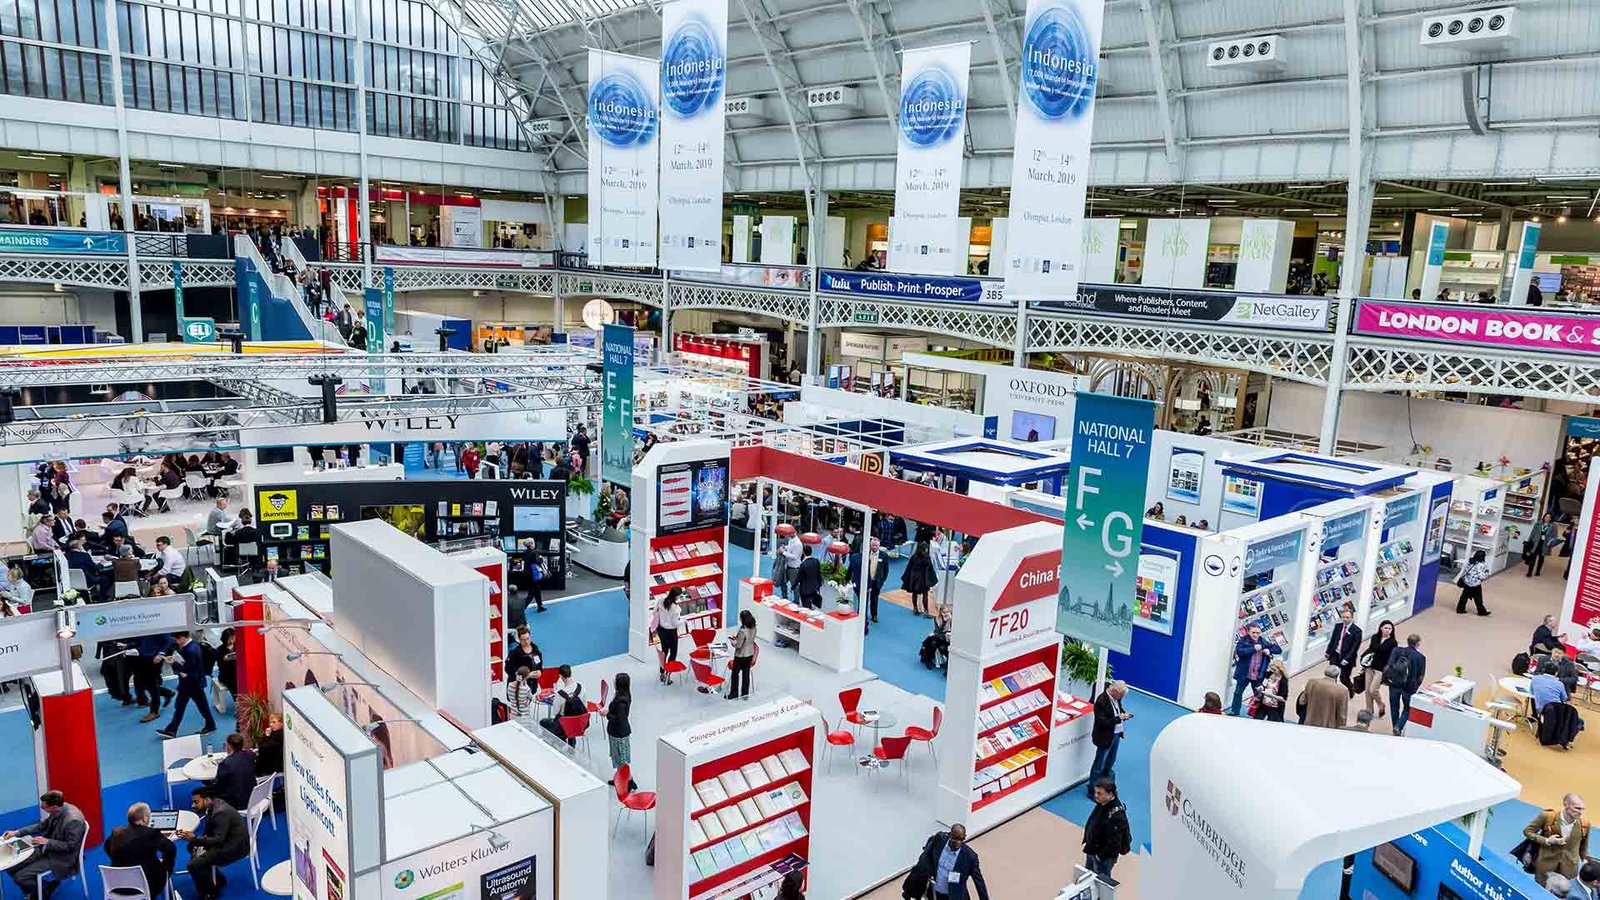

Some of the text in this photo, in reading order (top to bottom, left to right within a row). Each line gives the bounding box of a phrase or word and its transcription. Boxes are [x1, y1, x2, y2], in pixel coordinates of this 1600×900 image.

[666, 55, 722, 77] Indonesia
[1028, 43, 1094, 77] Indonesia
[593, 98, 655, 118] Indonesia
[904, 97, 962, 114] Indonesia
[1057, 171, 1076, 185] 2019
[831, 276, 965, 297] lulu Publish. Print. Prosper.
[1114, 293, 1208, 309] Where Publishers, Content,
[1128, 304, 1191, 317] and Readers Meet
[1253, 302, 1320, 321] NetGalley
[252, 302, 258, 323] C
[189, 323, 210, 336] ELI
[368, 320, 376, 342] D
[1378, 310, 1480, 335] LONDON
[1485, 319, 1565, 342] BOOK
[1566, 325, 1585, 344] &
[605, 342, 632, 356] NATIONAL
[609, 354, 628, 366] HALL 7
[606, 370, 617, 401] E
[1010, 379, 1067, 397] OXFORD
[360, 410, 460, 431] WILEY
[620, 398, 631, 428] F
[1078, 420, 1147, 445] NATIONAL
[1087, 438, 1135, 460] HALL 7
[510, 487, 560, 500] WILEY
[1075, 466, 1102, 510] F
[1101, 510, 1134, 558] G
[1019, 569, 1054, 589] China
[988, 608, 1030, 640] 7F20
[688, 698, 813, 744] Chinese Language Teaching & Learning
[290, 751, 305, 778] New
[305, 768, 325, 800] titles
[325, 789, 343, 822] from
[1182, 799, 1247, 876] CAMBRIDGE
[419, 856, 468, 880] Wolters
[470, 843, 510, 862] Kluwer
[1181, 814, 1243, 889] UNIVERSITY PRESS
[486, 864, 532, 889] Ultrasound
[489, 876, 529, 897] Anatomy
[1450, 858, 1484, 888] Author
[1484, 883, 1506, 900] Hub
